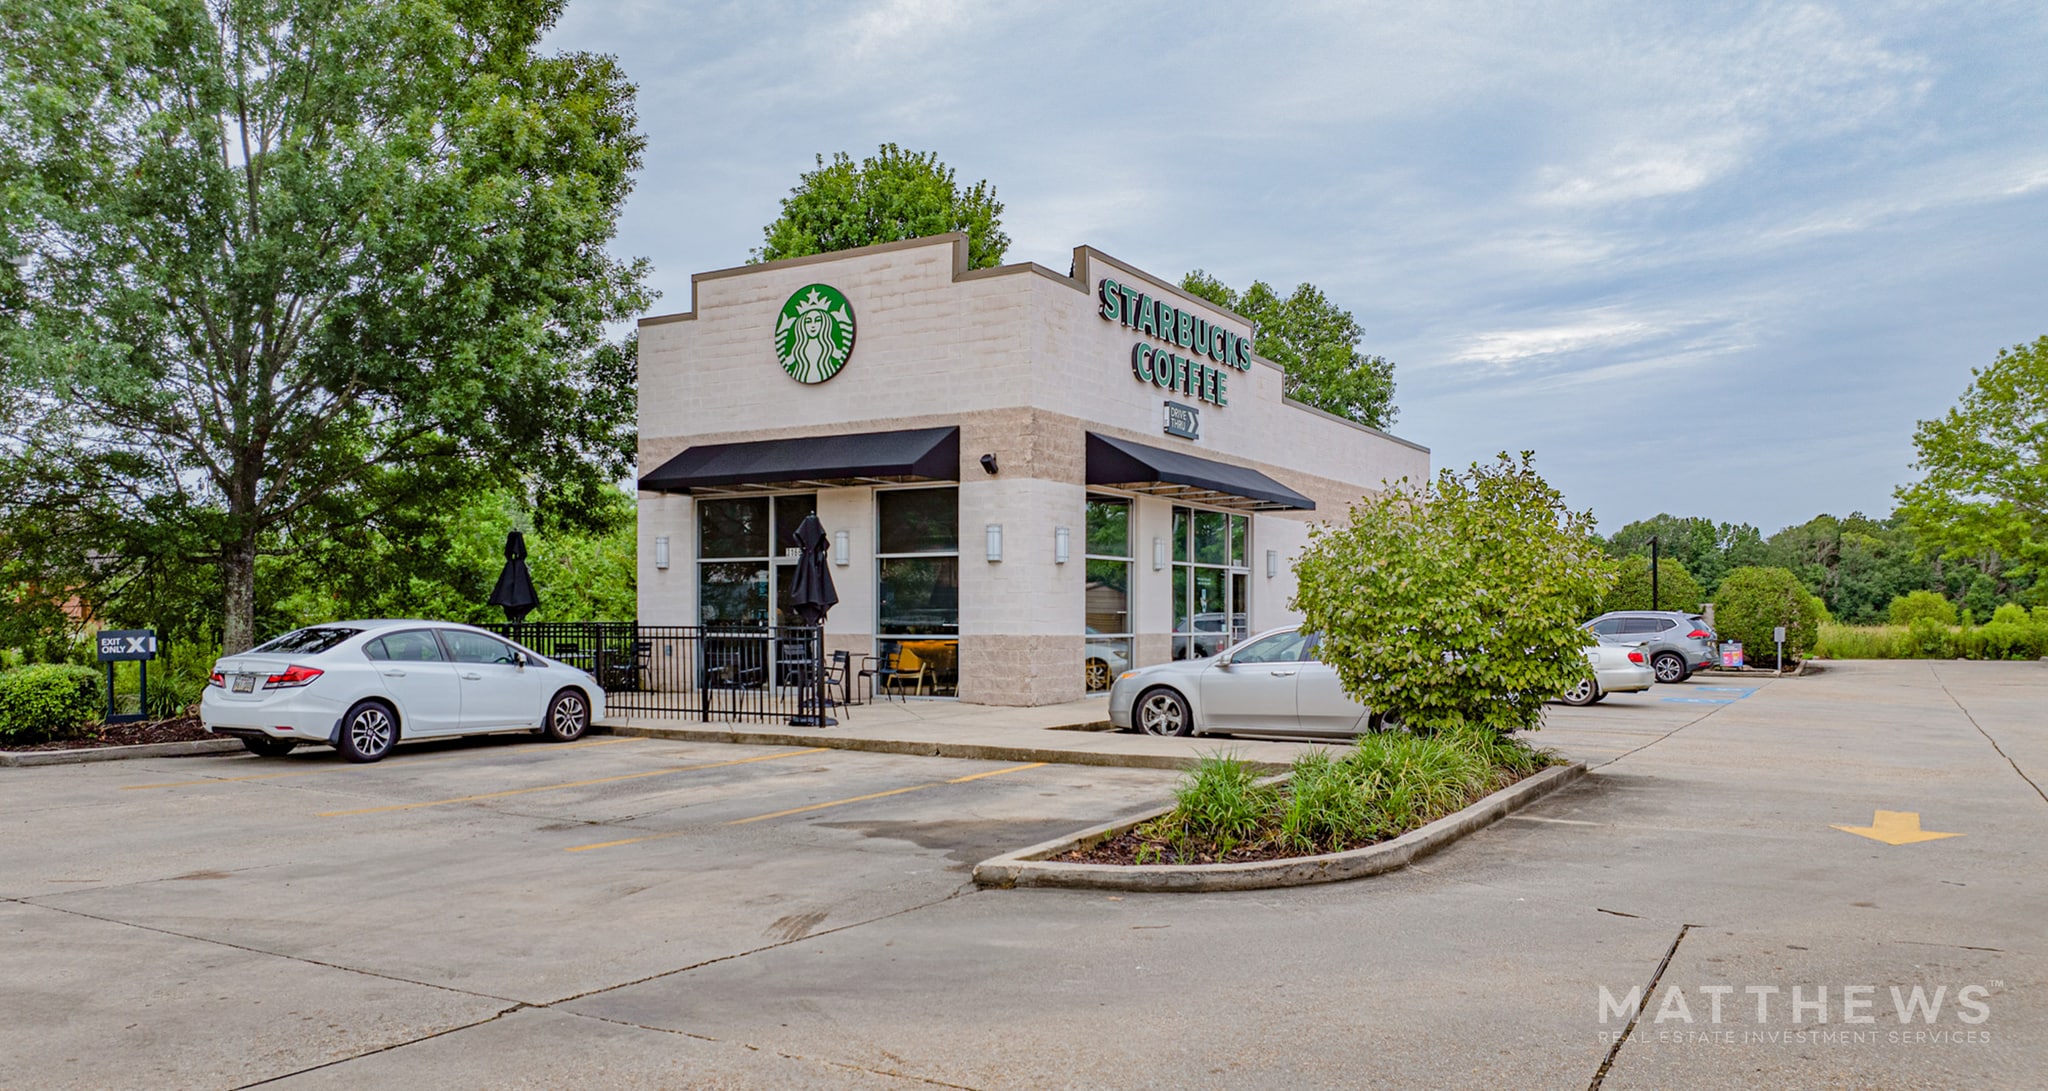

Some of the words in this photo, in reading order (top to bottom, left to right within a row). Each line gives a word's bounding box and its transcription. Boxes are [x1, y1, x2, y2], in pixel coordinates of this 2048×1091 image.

[1101, 278, 1252, 372] STARBUCKS
[1134, 342, 1228, 407] COFFEE
[1170, 407, 1188, 420] DRIVE
[1171, 418, 1187, 431] THRU
[101, 637, 121, 646] EXIT
[101, 645, 126, 654] ONLY
